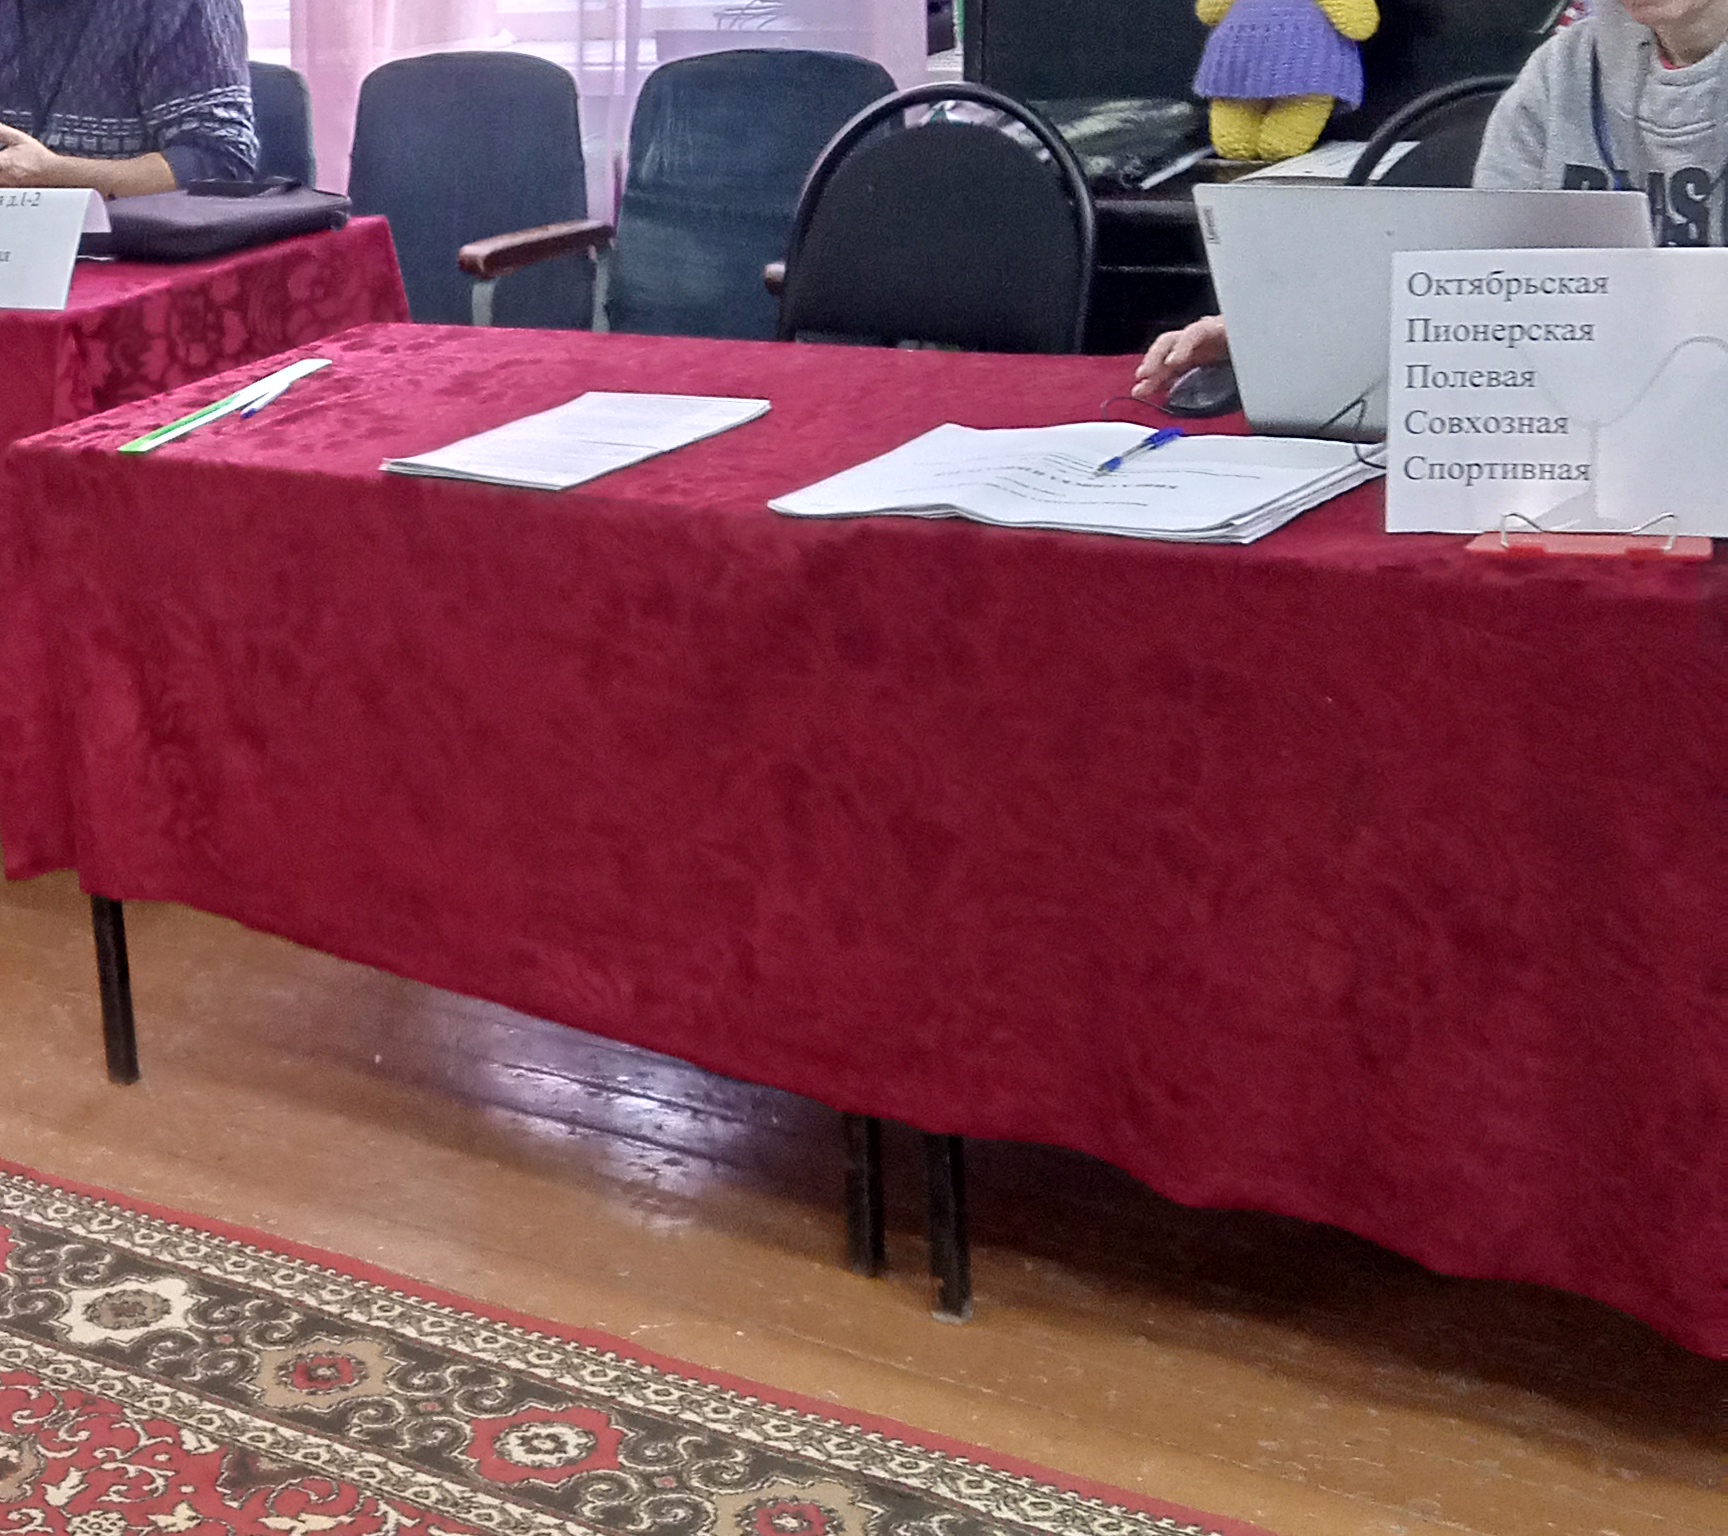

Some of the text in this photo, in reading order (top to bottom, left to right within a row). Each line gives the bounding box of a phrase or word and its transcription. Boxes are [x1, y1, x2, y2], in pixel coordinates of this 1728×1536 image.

[1407, 269, 1610, 302] Октябрьская
[1404, 317, 1596, 349] Пионерская
[1404, 364, 1538, 389] Полевая
[1403, 409, 1570, 435] Совхозная
[1402, 455, 1592, 486] Спортивная
